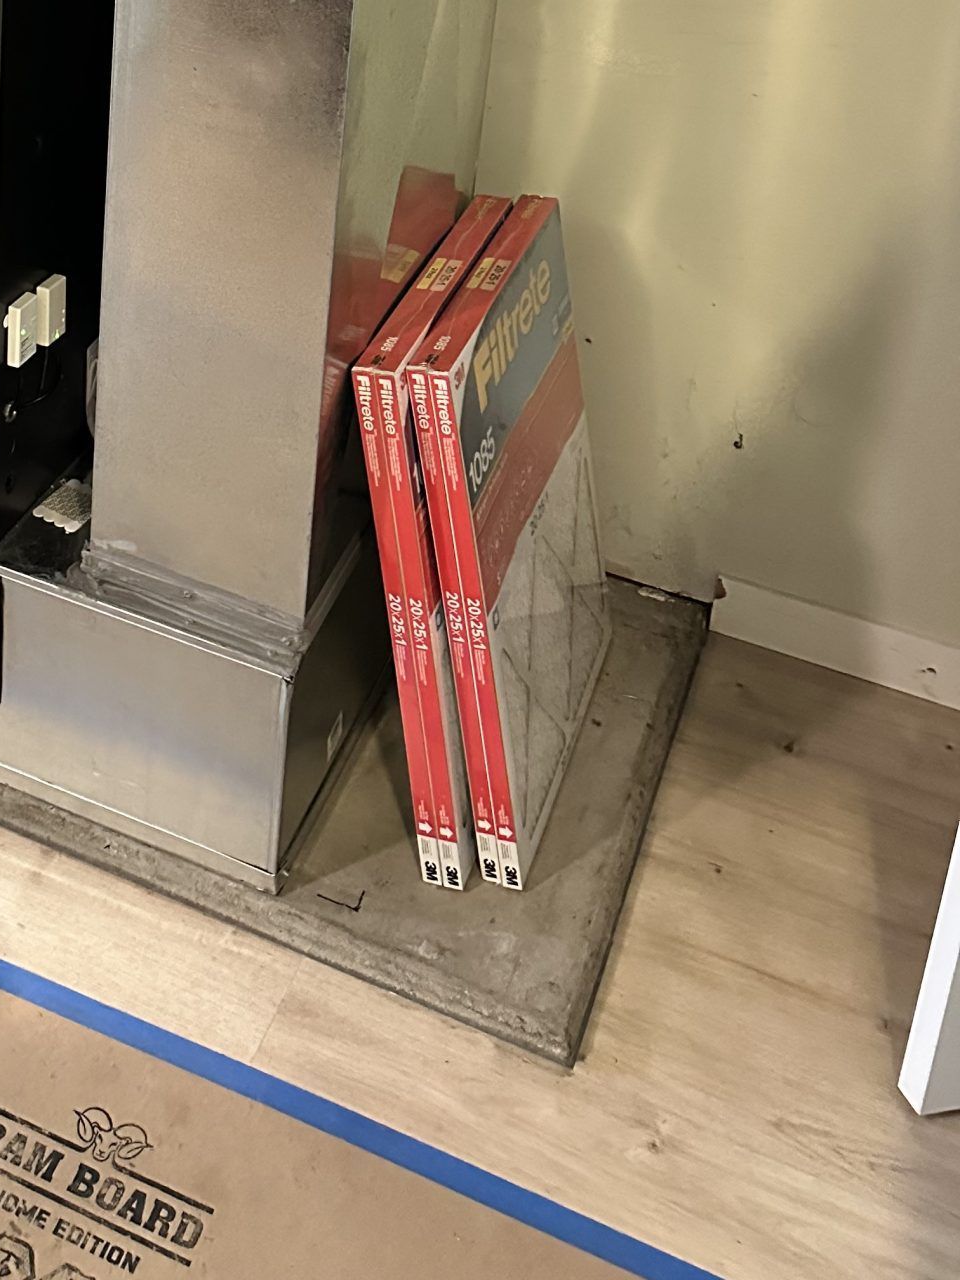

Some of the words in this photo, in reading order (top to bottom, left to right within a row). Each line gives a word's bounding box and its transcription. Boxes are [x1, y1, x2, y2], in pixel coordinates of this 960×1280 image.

[472, 259, 552, 415] Filtrete
[356, 375, 375, 431] Filtrete
[378, 378, 397, 435] Filtrete
[411, 373, 431, 430] Filtrete
[433, 378, 453, 435] Filtrete
[468, 425, 496, 493] 1085
[388, 593, 408, 646] 20x25x1
[409, 597, 429, 651] 20x25x1
[445, 591, 466, 644] 20x25x1
[466, 597, 487, 651] 20x25x1
[425, 860, 439, 881] 3M
[445, 865, 460, 887] 3M
[483, 858, 498, 879] 3M
[504, 865, 519, 887] 3M
[66, 1162, 205, 1249] BOARD
[52, 1217, 142, 1275] EDITION
